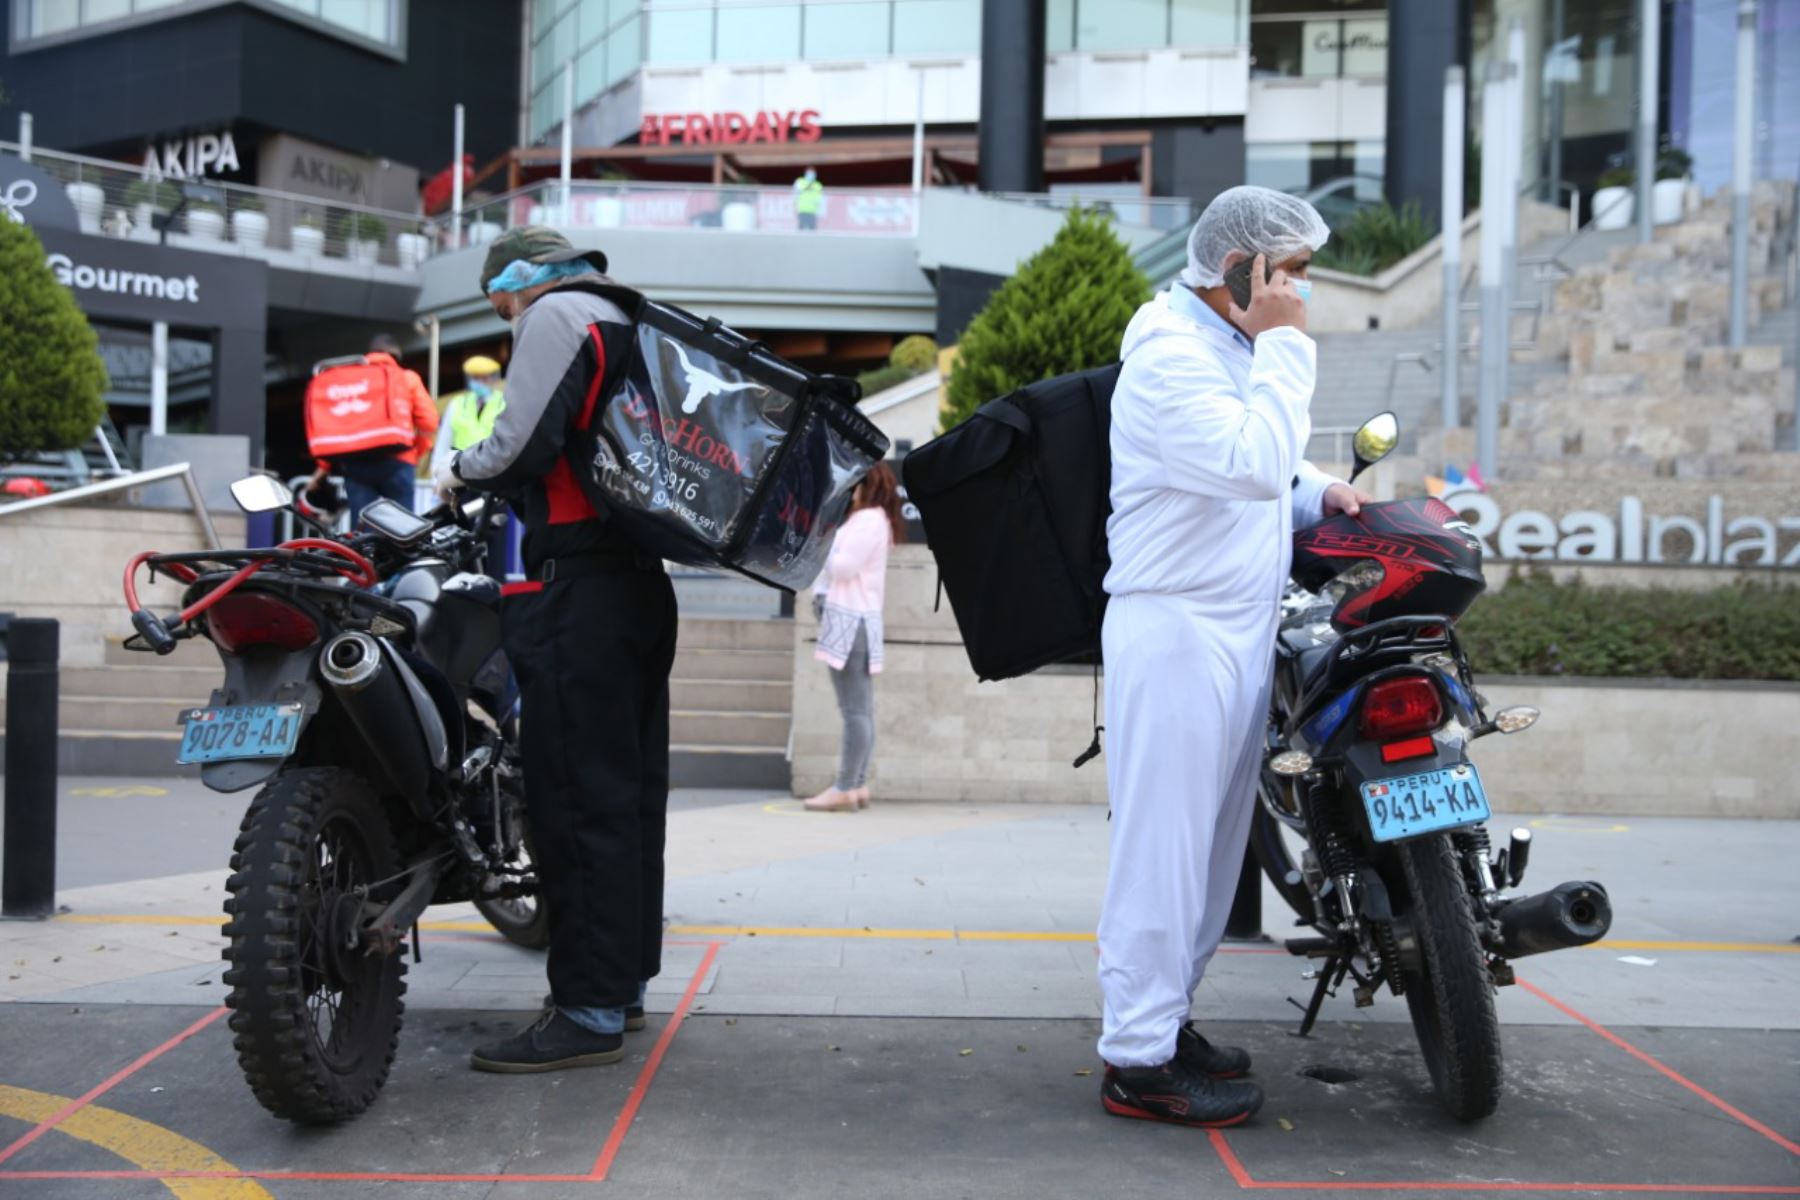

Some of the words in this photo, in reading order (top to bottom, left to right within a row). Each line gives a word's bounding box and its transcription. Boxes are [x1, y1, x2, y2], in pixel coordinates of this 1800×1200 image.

[660, 109, 822, 145] FRIDAYS
[143, 131, 240, 183] AKIPA
[45, 253, 199, 302] Gourmet
[627, 451, 660, 478] 421
[659, 468, 700, 500] 3916
[187, 718, 290, 753] 9078-AA
[1373, 781, 1480, 829] 9414-KA
[1396, 772, 1441, 792] PERU
